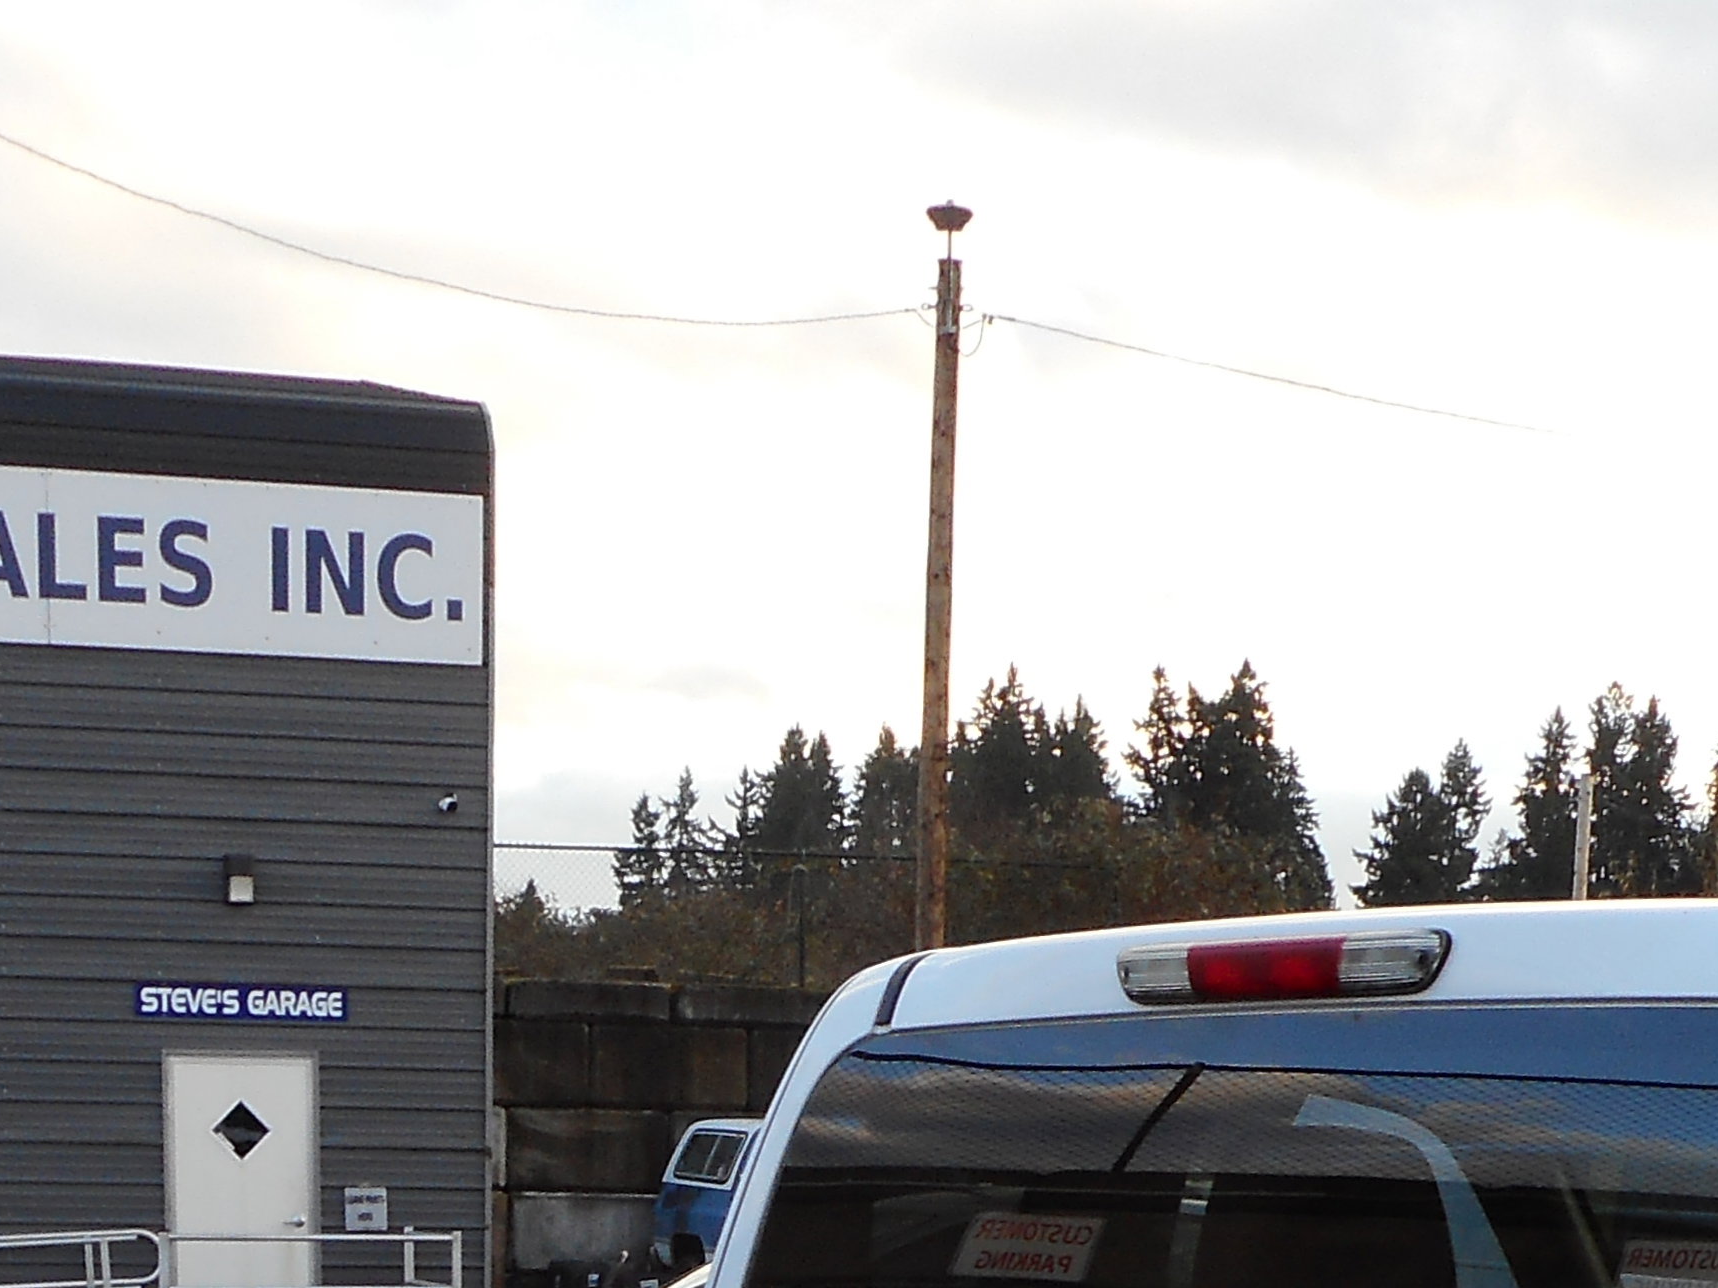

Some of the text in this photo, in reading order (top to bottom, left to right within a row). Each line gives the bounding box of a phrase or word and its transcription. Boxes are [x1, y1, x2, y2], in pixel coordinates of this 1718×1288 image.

[269, 525, 465, 624] INC.
[140, 986, 343, 1017] STEVE'S GARAGE
